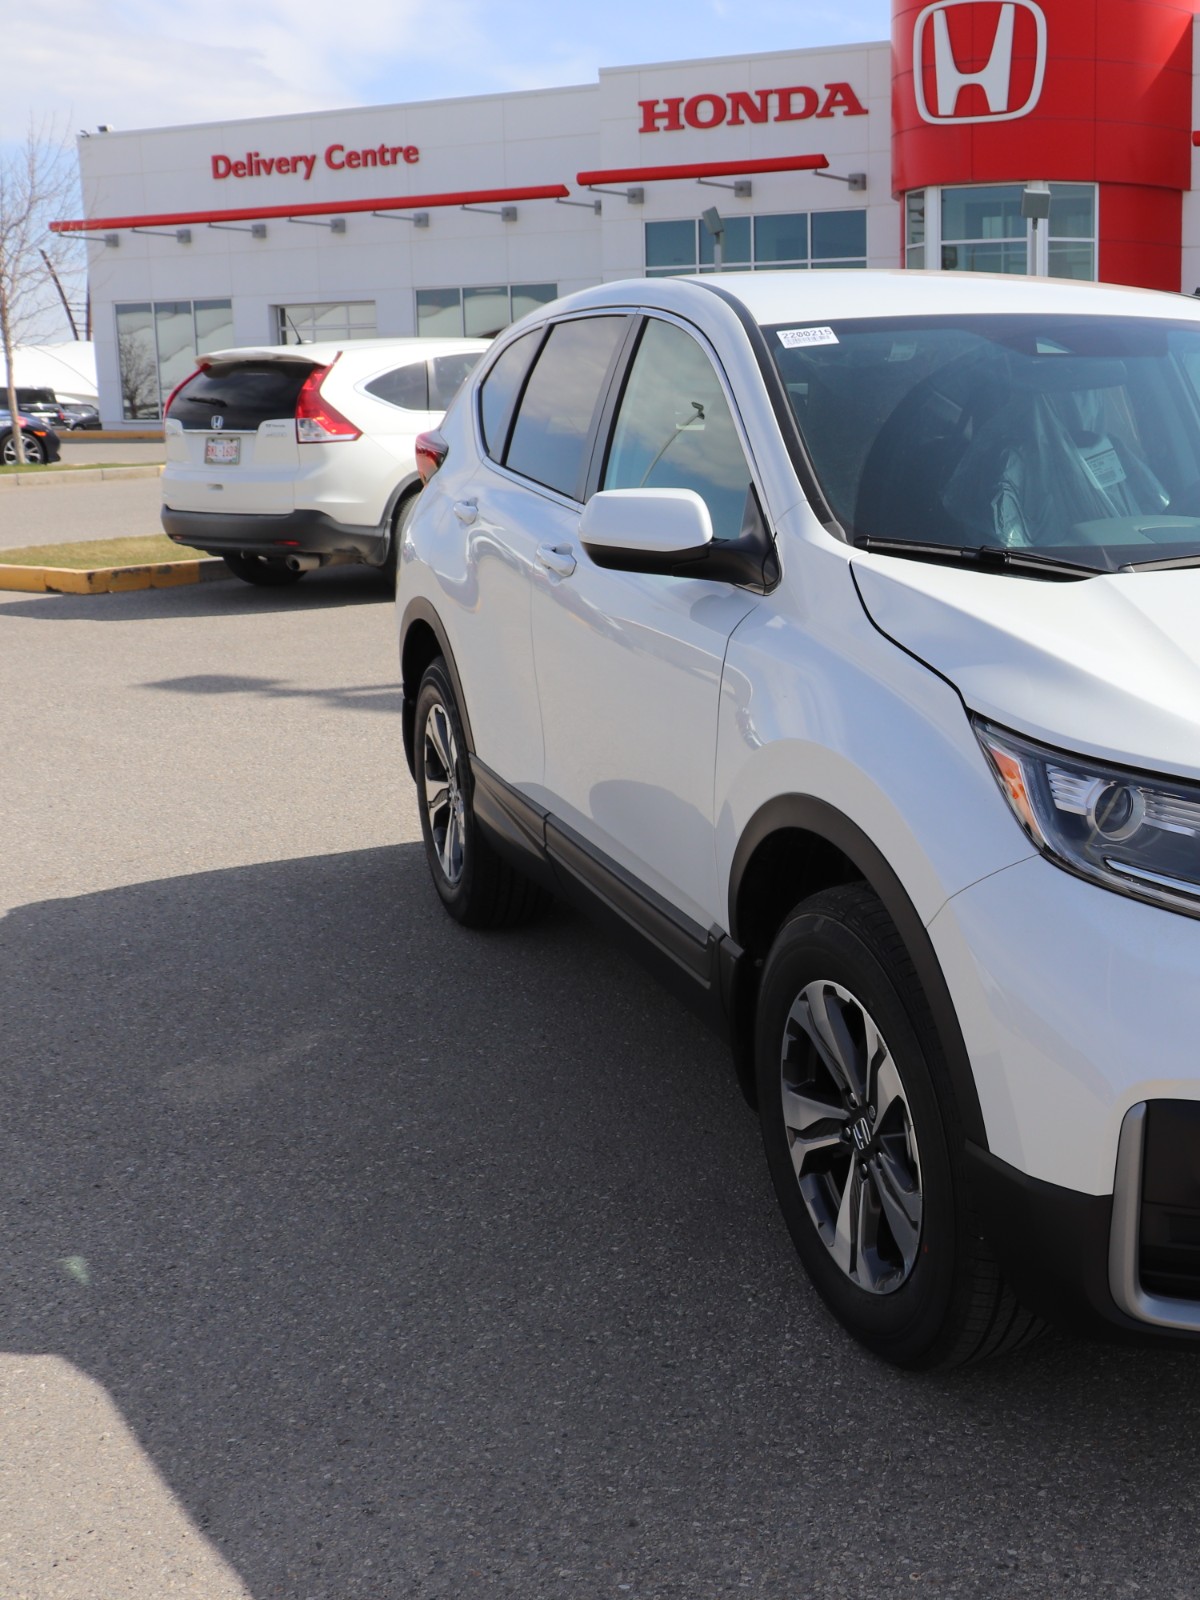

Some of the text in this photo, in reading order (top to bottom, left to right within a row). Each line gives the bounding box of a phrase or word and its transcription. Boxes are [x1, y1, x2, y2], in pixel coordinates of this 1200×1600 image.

[637, 82, 869, 133] HONDA
[211, 143, 420, 180] Delivery Centre
